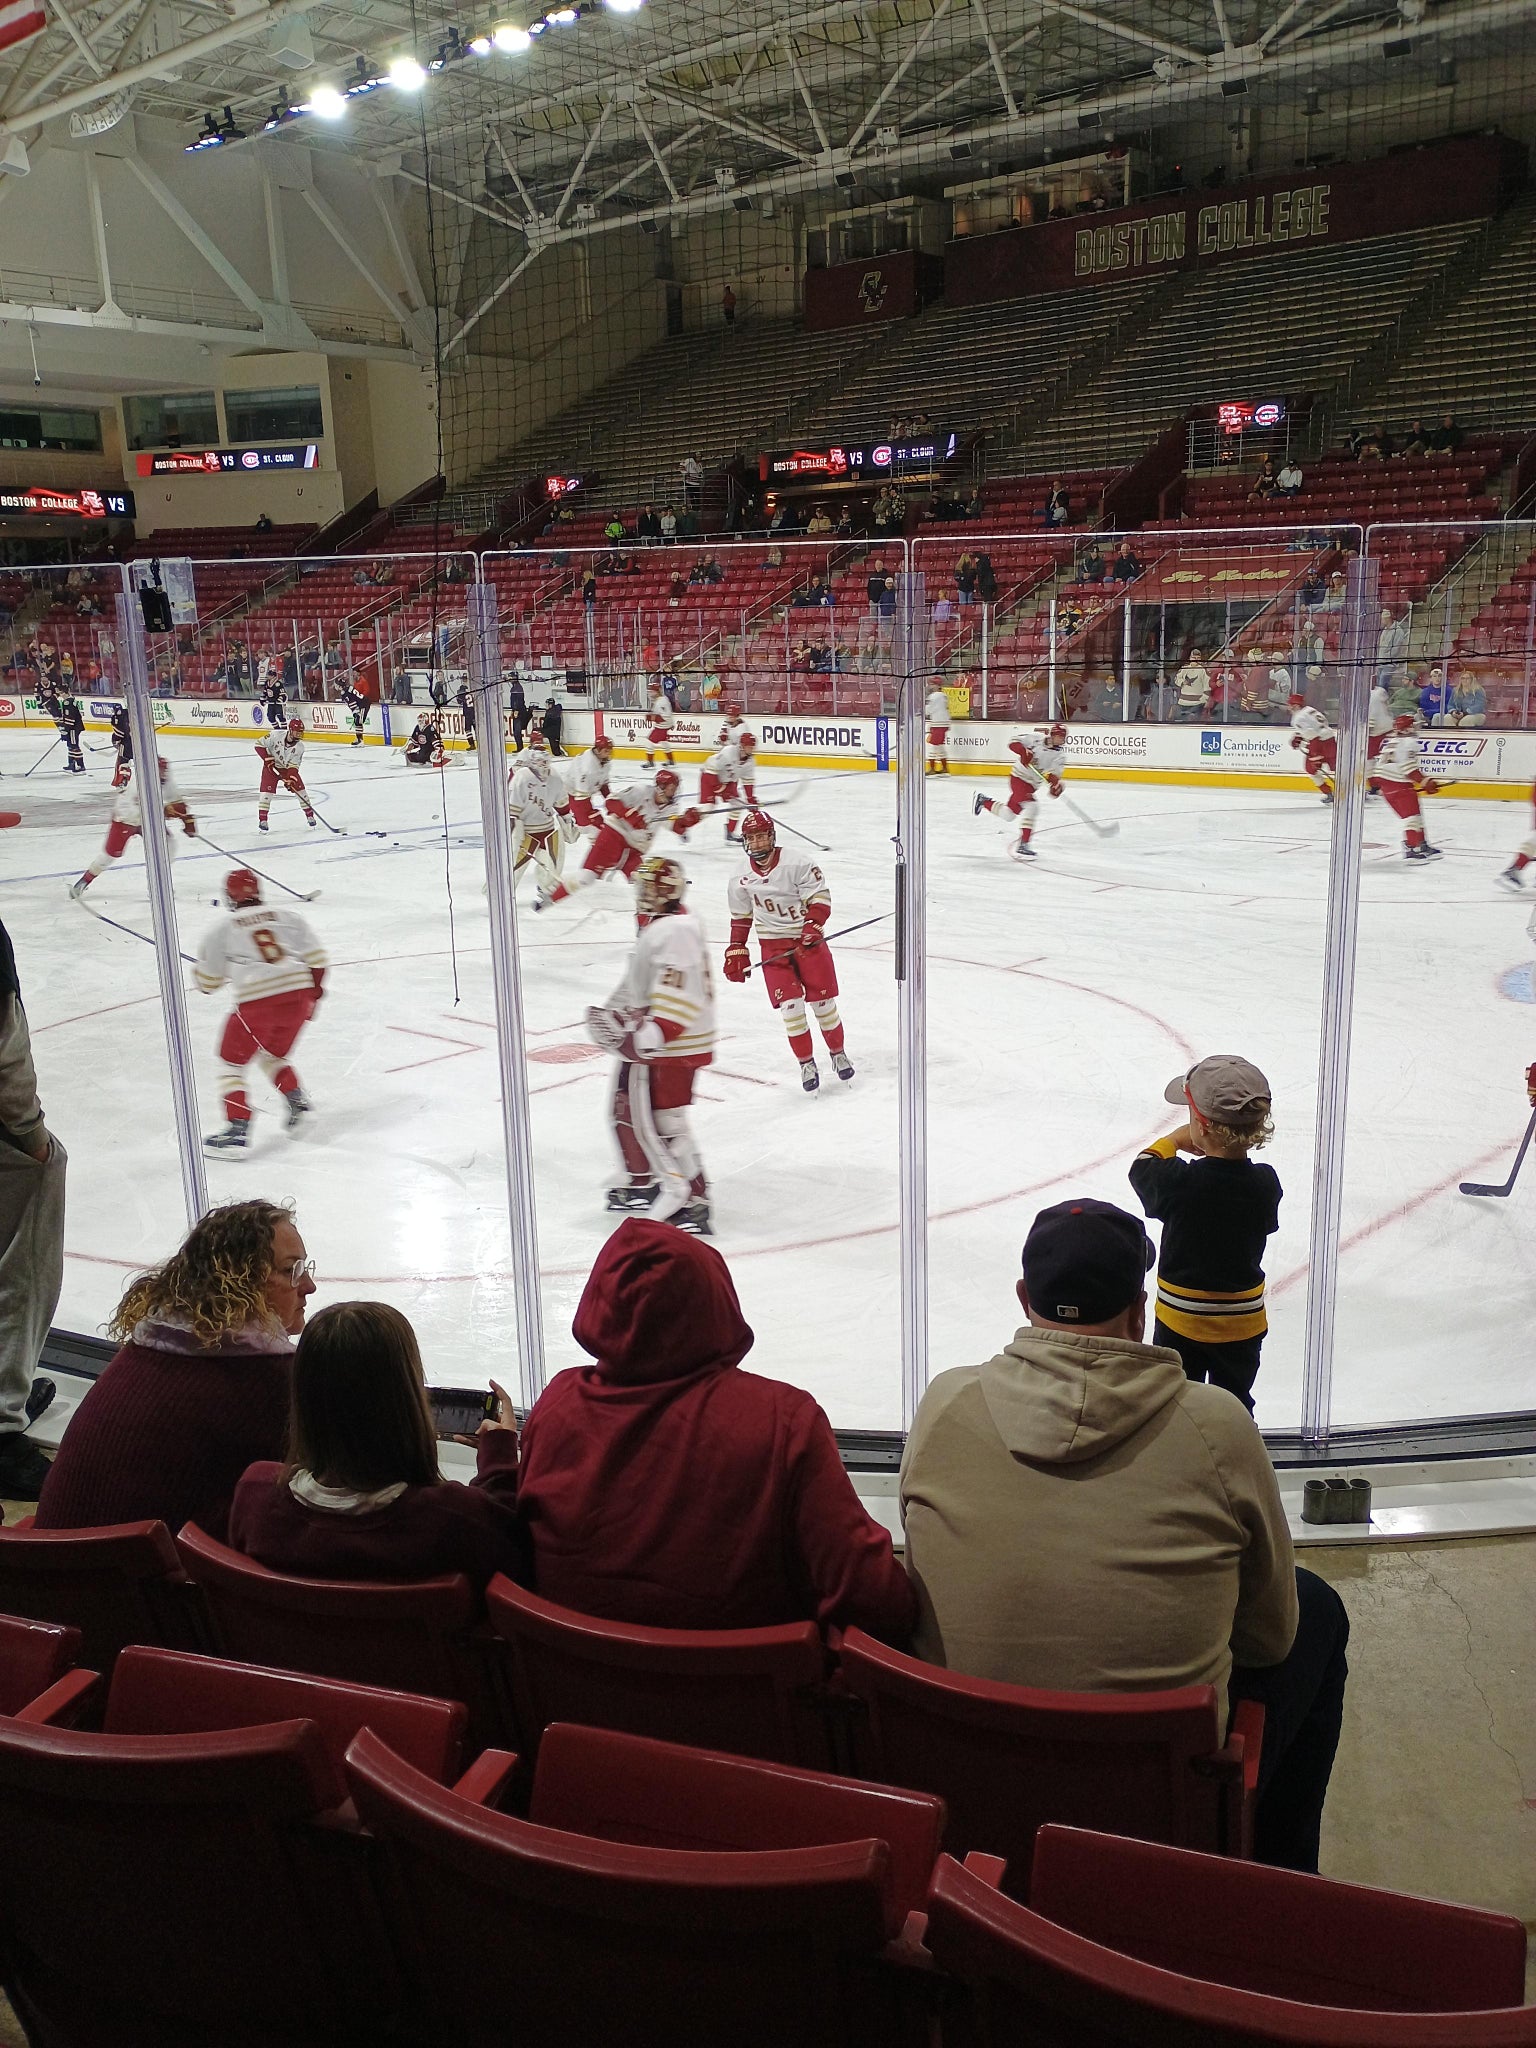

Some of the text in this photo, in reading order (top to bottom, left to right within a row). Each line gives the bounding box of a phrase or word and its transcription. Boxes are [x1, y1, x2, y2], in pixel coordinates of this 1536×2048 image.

[1074, 184, 1331, 277] BOSTON COLLEGE
[155, 460, 177, 470] BOSTON
[179, 459, 204, 468] COLLEGE
[221, 455, 235, 467] VS
[262, 454, 274, 463] ST.
[275, 453, 295, 463] CLOUD
[801, 458, 828, 470] COLLEGE
[849, 451, 863, 465] VS
[0, 495, 37, 508] BOSTON
[41, 497, 79, 509] COLLEGE
[107, 497, 126, 512] VS
[191, 703, 224, 724] Wegmans
[421, 711, 466, 735] OSTO
[610, 718, 653, 729] FLYNN FUND
[676, 720, 700, 732] Boston
[762, 725, 862, 747] POWERADE
[953, 737, 990, 746] KENNEDY
[1103, 736, 1147, 748] COLLEGE
[1202, 736, 1220, 752] csb
[1095, 747, 1147, 757] SPONSORSHIPS
[1223, 738, 1281, 756] Cambridge
[1433, 741, 1468, 754] ETC.
[753, 893, 808, 921] AGLE
